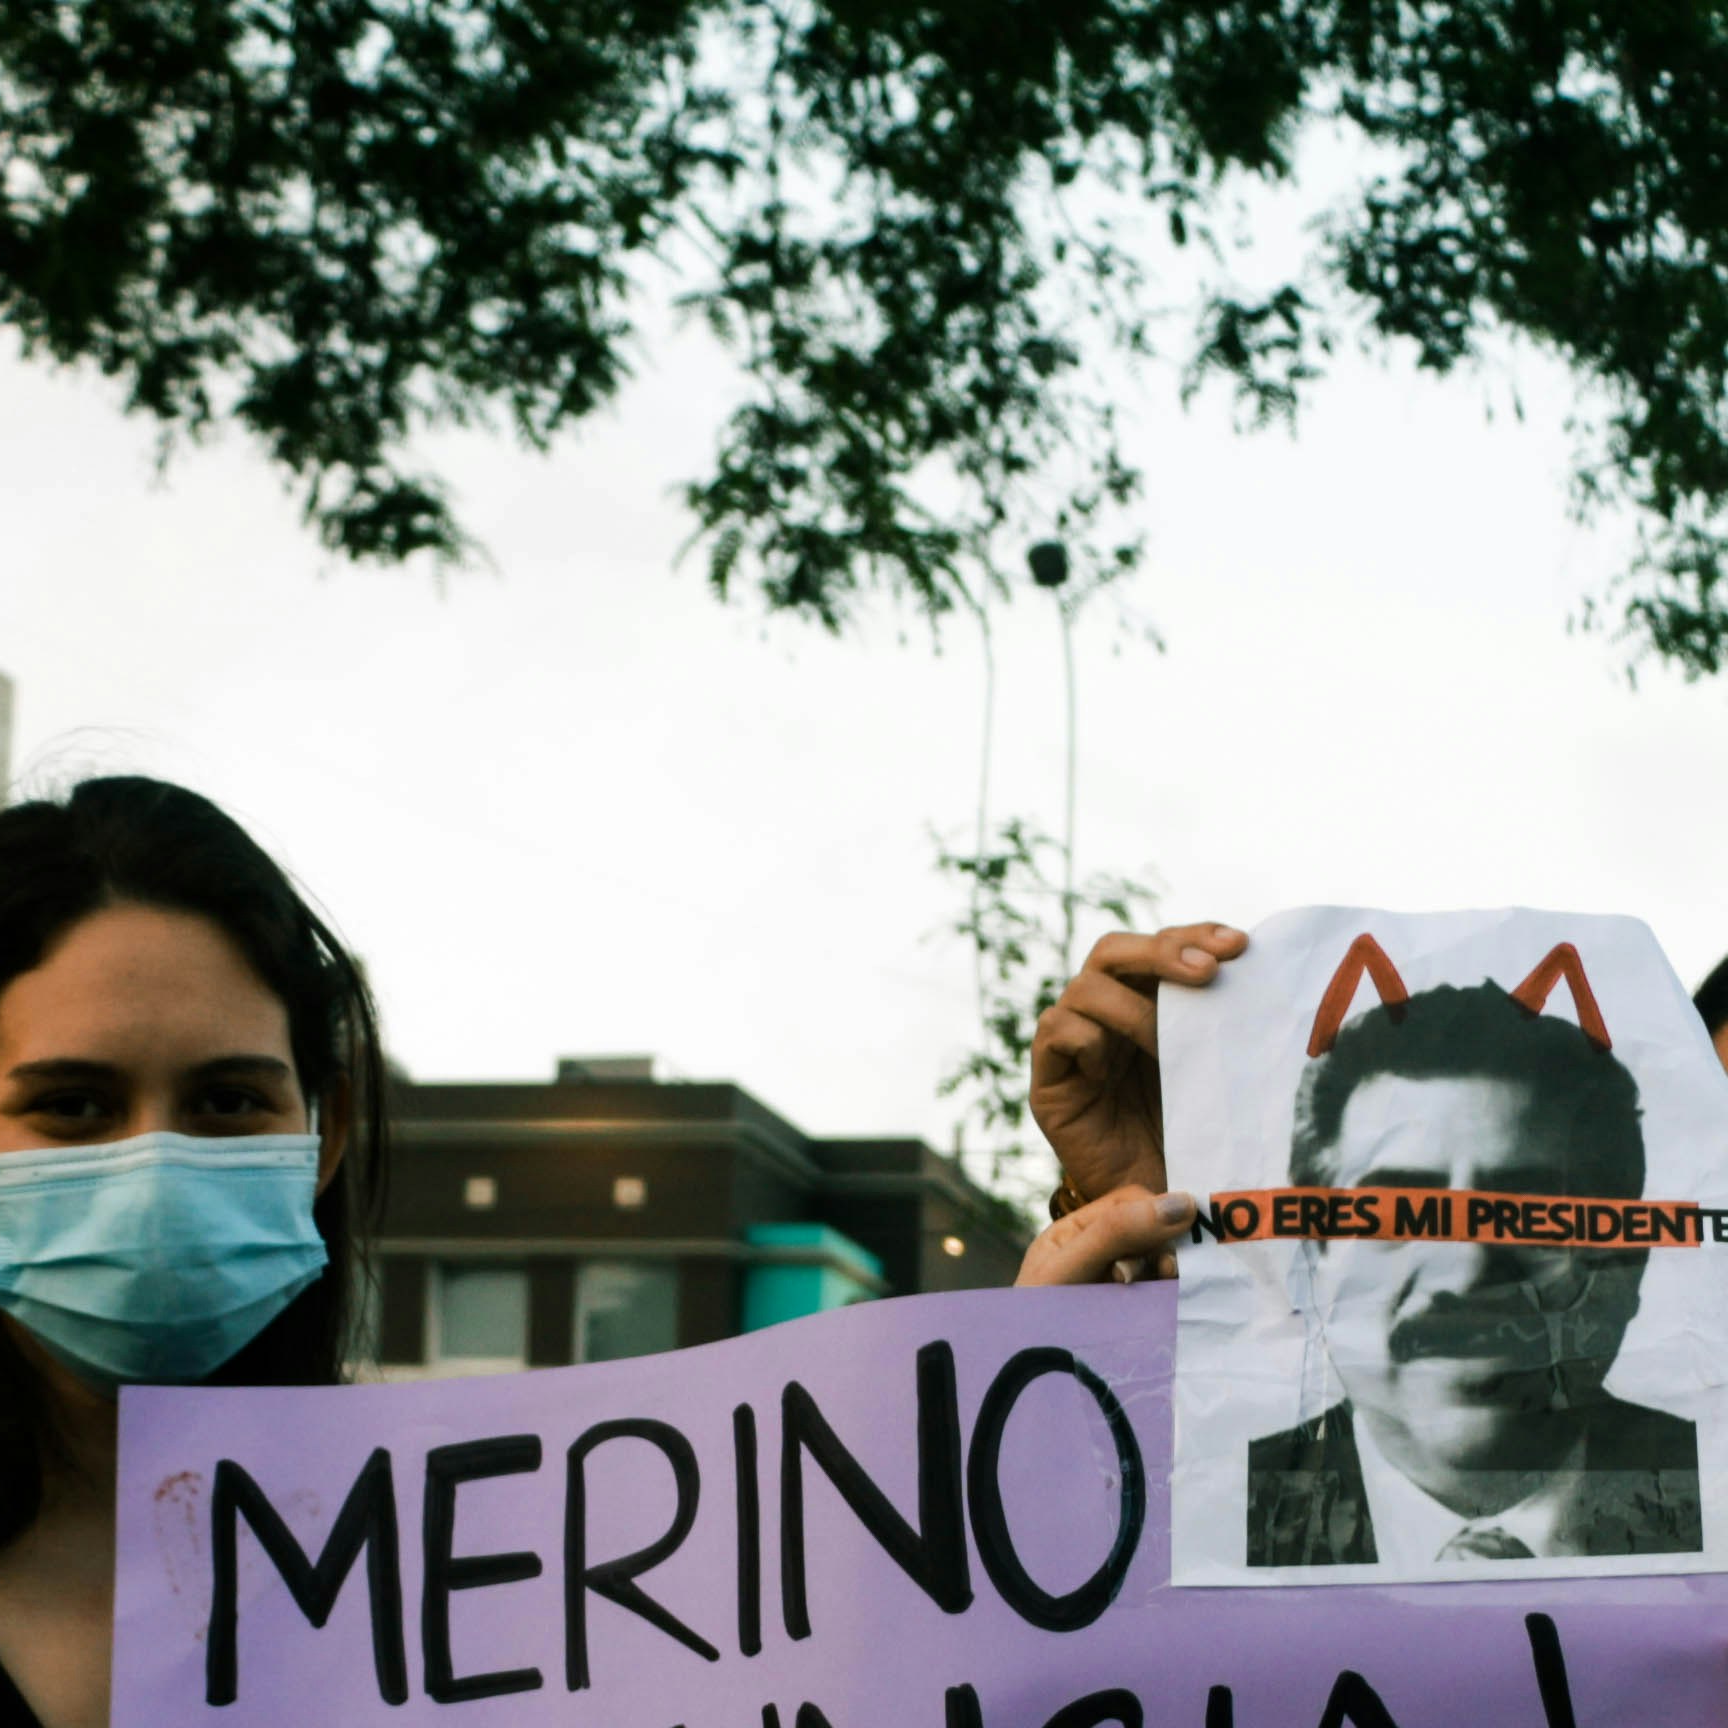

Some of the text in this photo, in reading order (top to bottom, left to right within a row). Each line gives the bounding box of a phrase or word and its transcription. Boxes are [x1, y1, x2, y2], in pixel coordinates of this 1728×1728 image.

[1190, 1199, 1260, 1244] NO
[1272, 1195, 1380, 1238] ERES
[1393, 1196, 1452, 1238] MI
[206, 1340, 1146, 1707] MERINO
